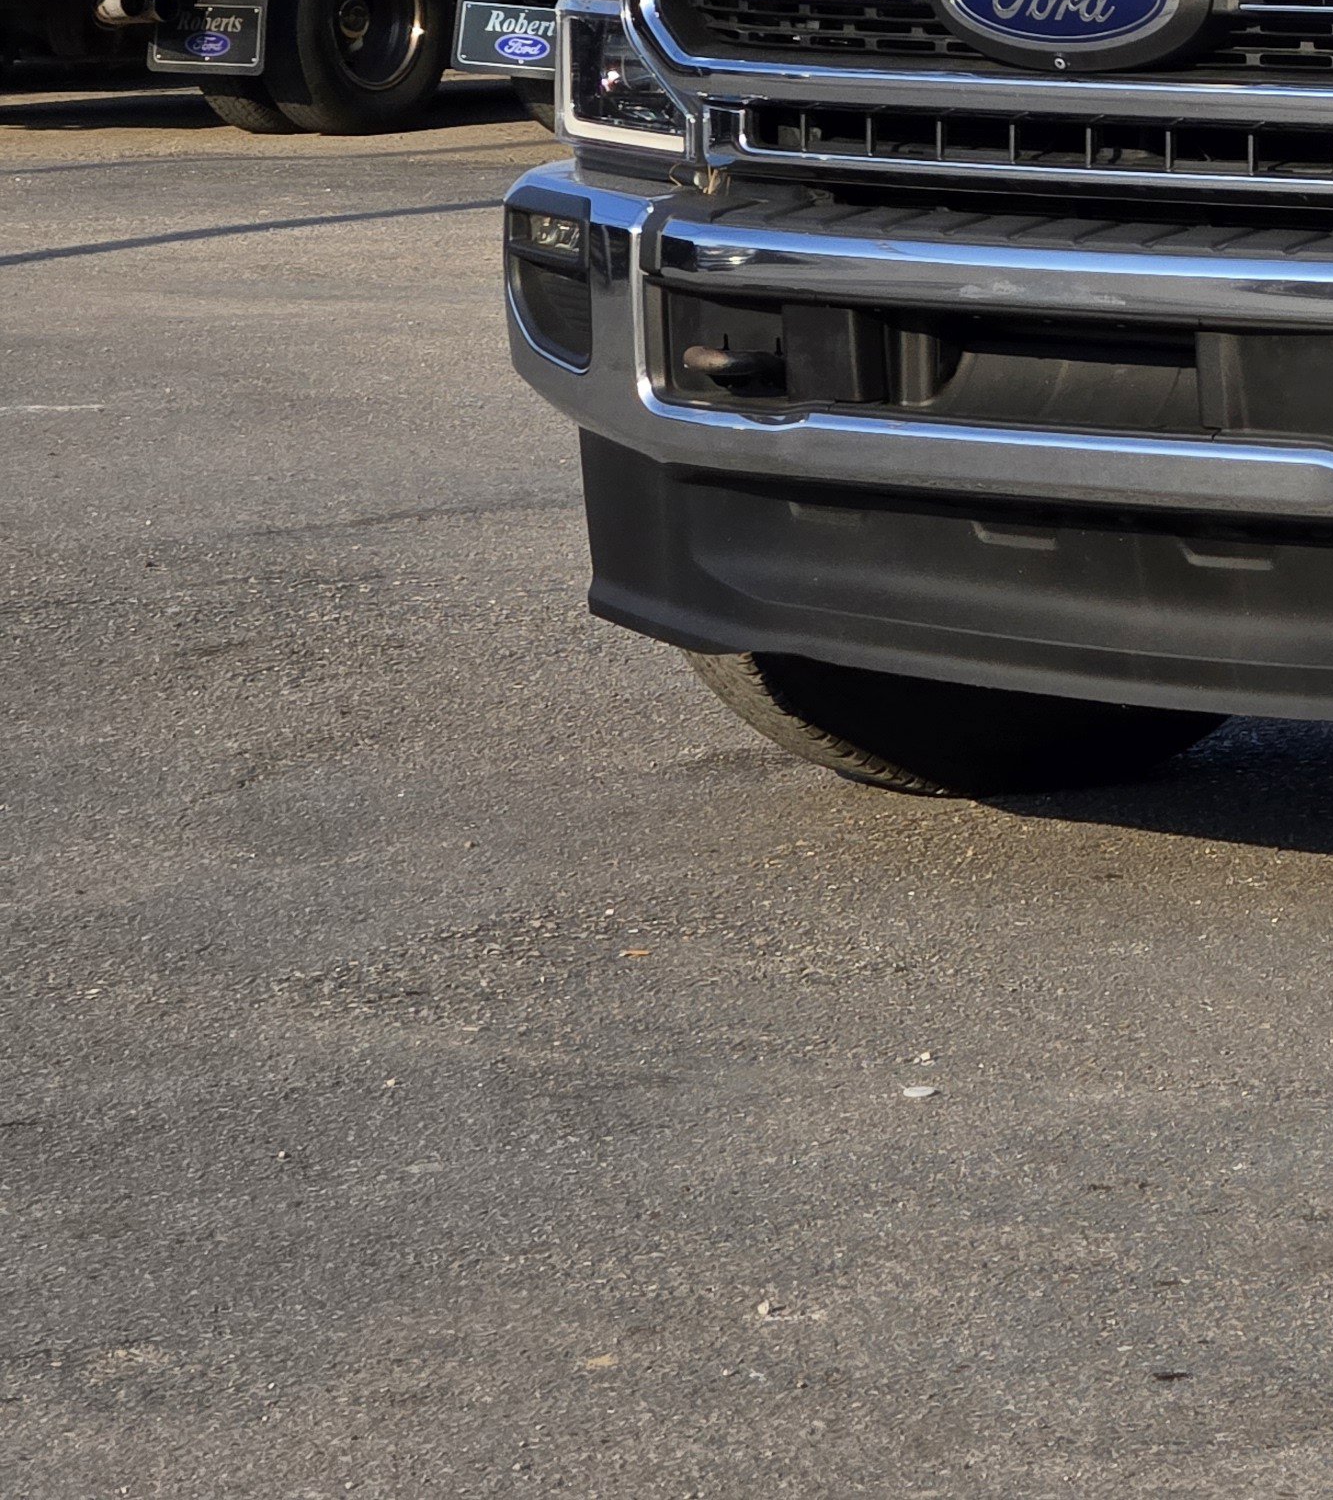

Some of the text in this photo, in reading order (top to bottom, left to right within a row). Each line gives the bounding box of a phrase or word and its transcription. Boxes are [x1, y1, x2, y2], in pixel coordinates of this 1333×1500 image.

[177, 9, 243, 33] Roberts
[485, 9, 557, 37] Robert
[192, 37, 223, 52] Ford
[504, 38, 543, 55] Ford
